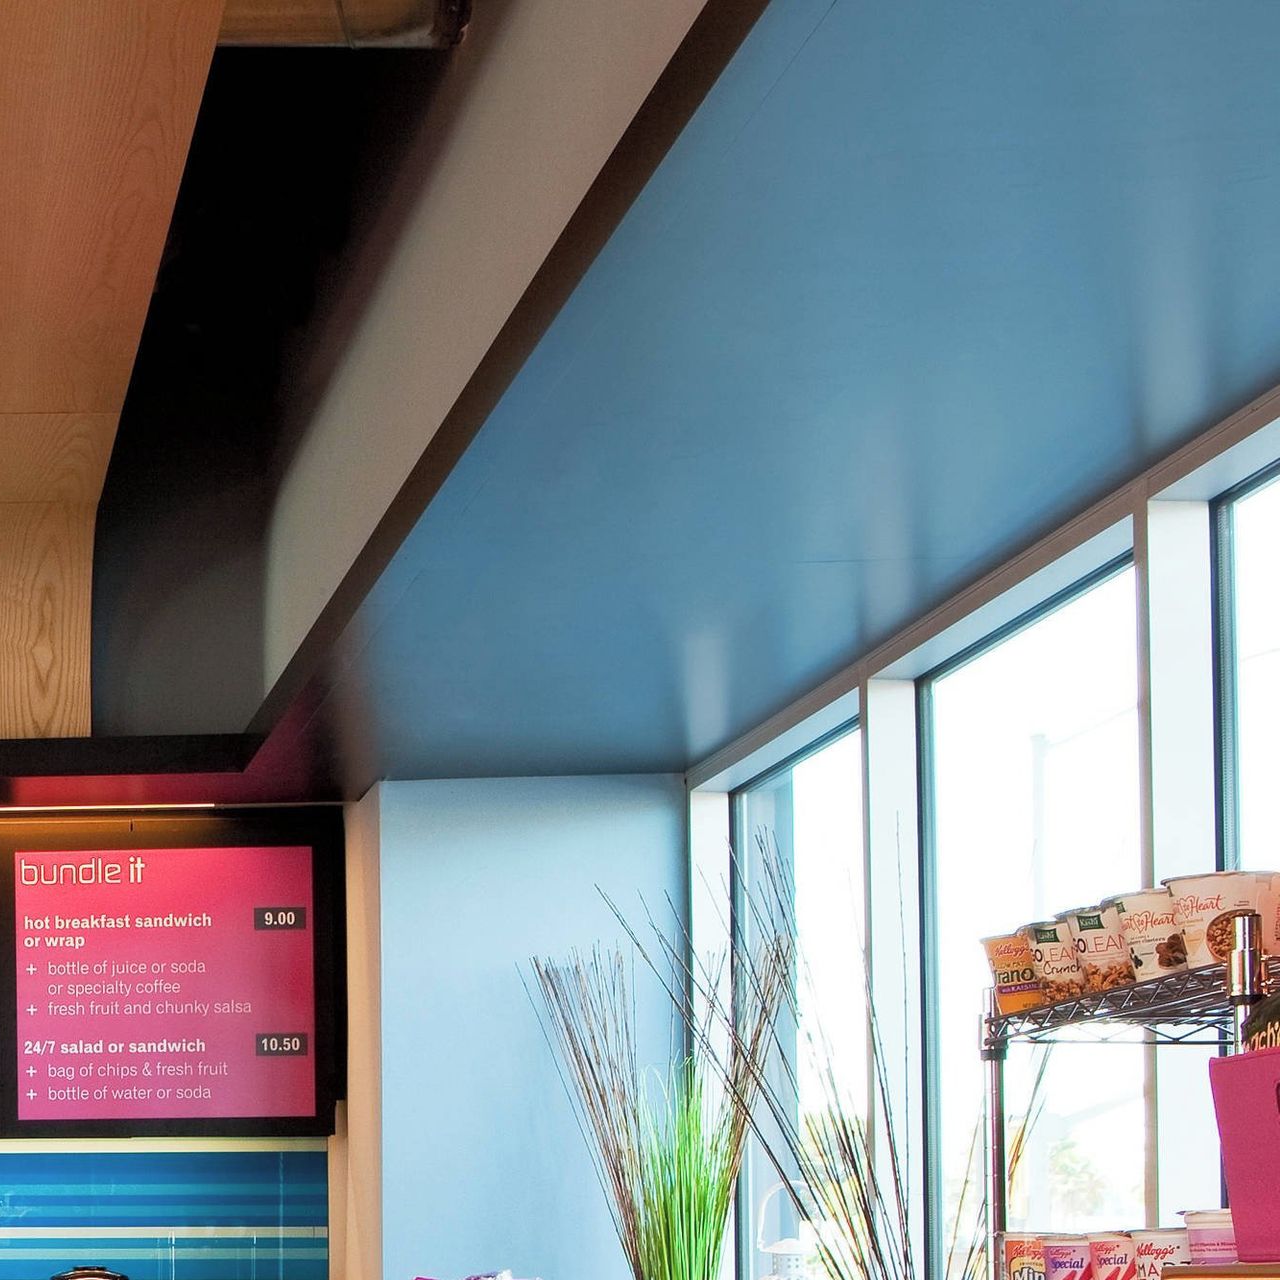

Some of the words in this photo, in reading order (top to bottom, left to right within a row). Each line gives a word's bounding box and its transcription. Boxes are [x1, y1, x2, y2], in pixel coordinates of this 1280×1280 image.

[21, 858, 121, 884] bundle
[130, 856, 145, 883] it
[25, 916, 50, 929] hot
[55, 915, 130, 929] breakfast
[135, 913, 211, 927] sandwich
[265, 912, 295, 925] 9.00
[24, 936, 40, 947] or
[45, 936, 84, 949] wrap
[48, 961, 89, 975] bottle
[94, 960, 107, 974] of
[112, 961, 146, 977] juice
[151, 962, 166, 973] or
[171, 960, 205, 973] soda
[24, 1040, 55, 1055] 24/7
[61, 1040, 103, 1053] salad
[108, 1042, 124, 1053] or
[129, 1039, 205, 1052] sandwich
[262, 1038, 299, 1051] 10.50
